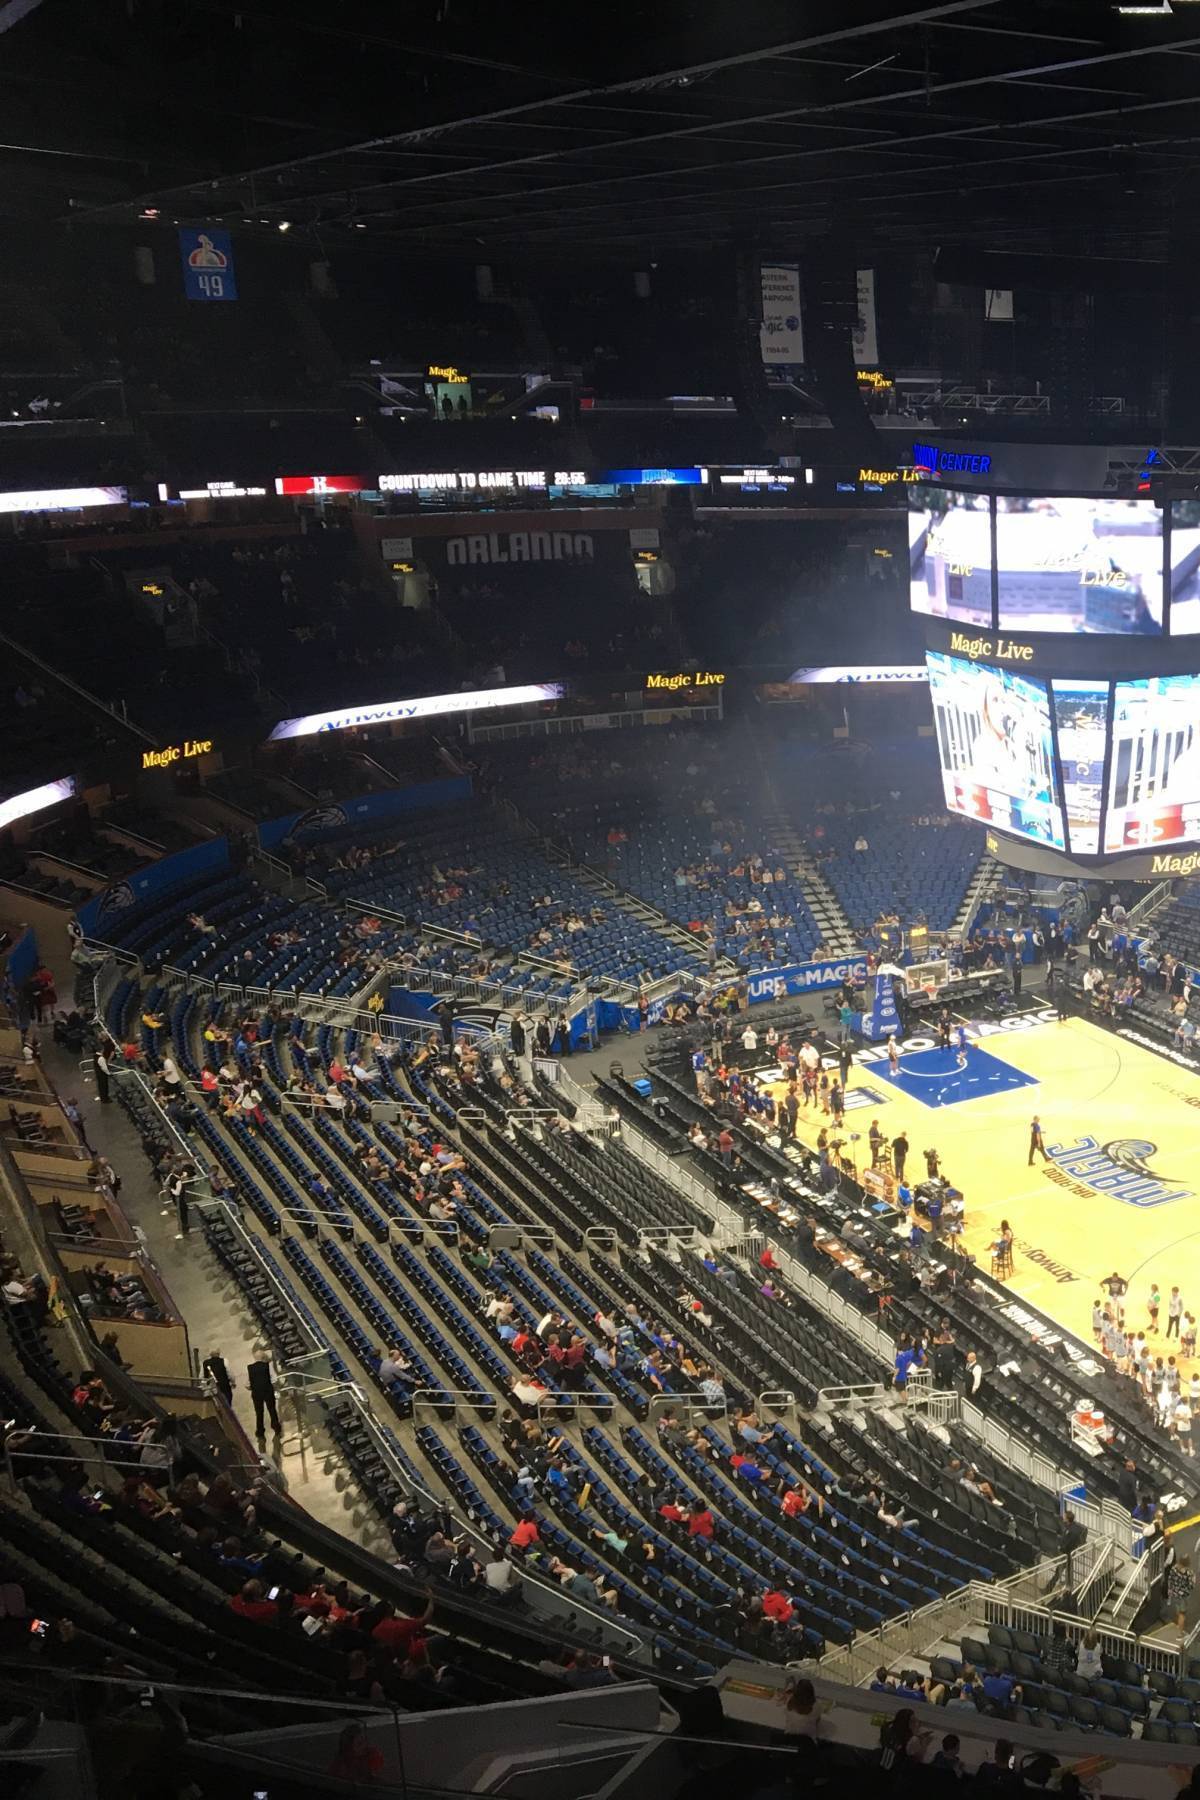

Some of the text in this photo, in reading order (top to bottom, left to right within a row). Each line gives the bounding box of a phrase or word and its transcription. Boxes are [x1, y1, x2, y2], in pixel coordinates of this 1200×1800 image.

[198, 275, 224, 297] 49
[428, 366, 458, 380] Magic
[448, 373, 468, 383] Live
[857, 371, 883, 382] Magic
[874, 379, 893, 388] Live
[940, 453, 991, 473] CENTER
[379, 474, 457, 491] COUNTDOWN
[459, 473, 476, 488] TO
[478, 472, 514, 487] GAME
[515, 471, 546, 486] TIME
[858, 469, 921, 485] Magic Liv
[447, 531, 594, 564] ORLANDO
[950, 633, 1034, 661] Magic Live
[646, 672, 725, 691] Magic Live
[836, 674, 930, 684] Amwa
[317, 706, 418, 732] Amway
[142, 740, 212, 769] Magic Live
[986, 836, 999, 853] ive
[749, 962, 867, 997] URE MAGIC
[1116, 1028, 1200, 1068] @OrlandoMagic
[1044, 1134, 1197, 1210] MAGIC
[1043, 1167, 1098, 1200] ORLANDO
[1025, 1248, 1081, 1284] Amway
